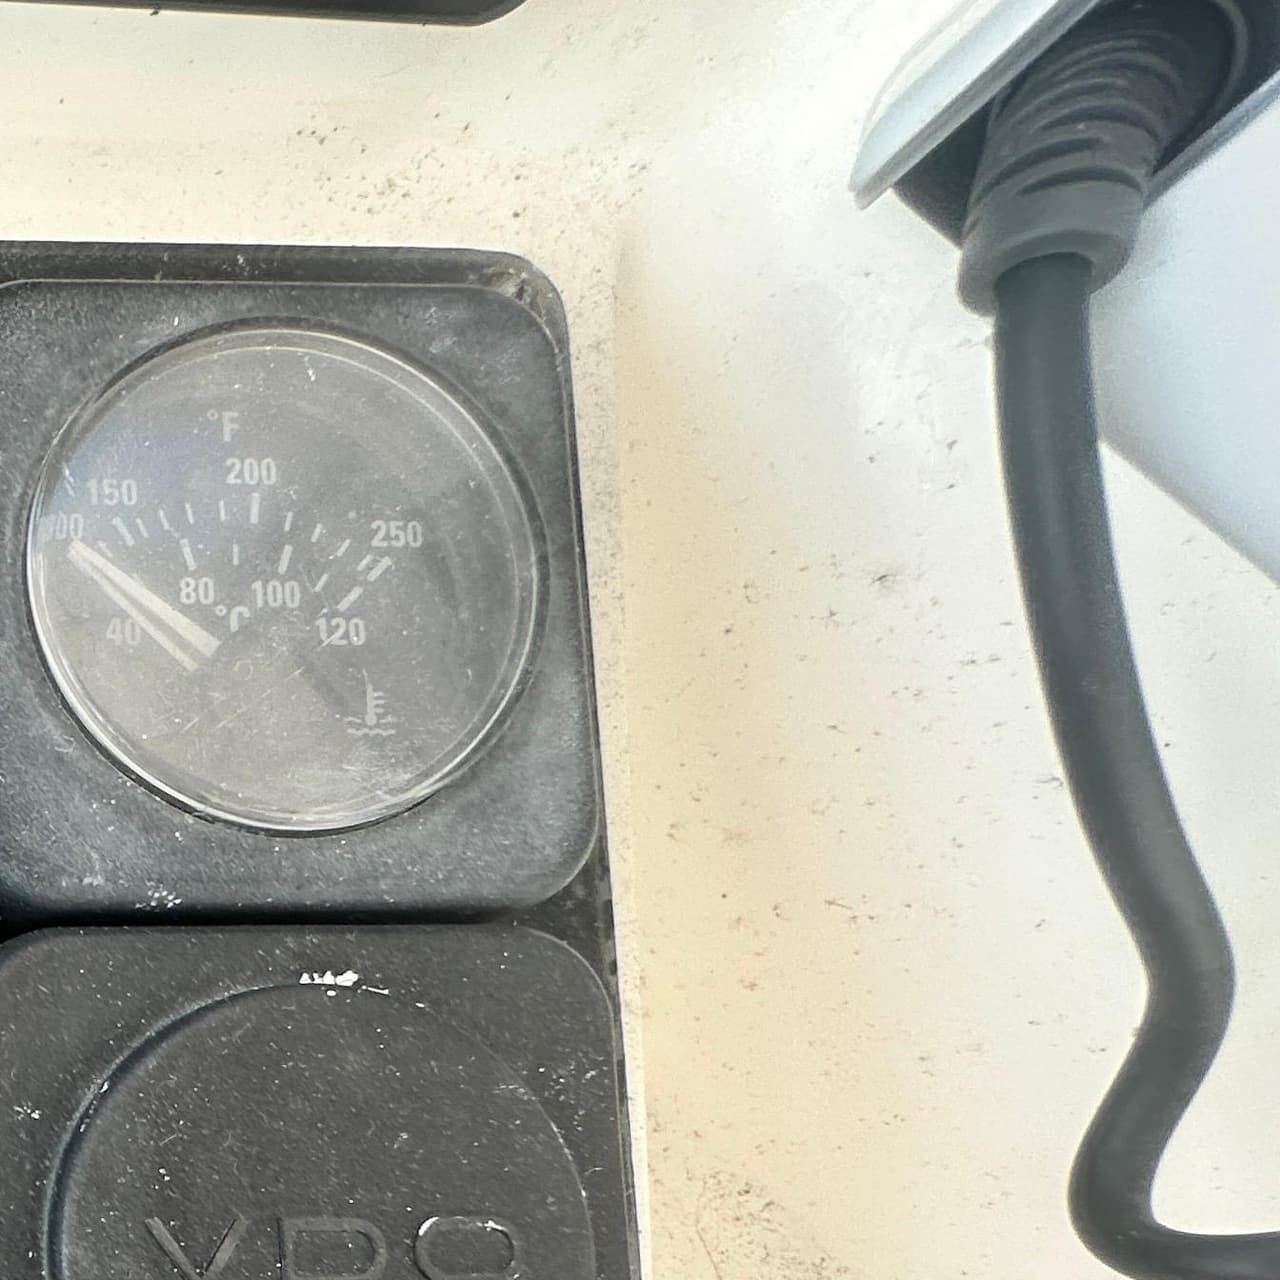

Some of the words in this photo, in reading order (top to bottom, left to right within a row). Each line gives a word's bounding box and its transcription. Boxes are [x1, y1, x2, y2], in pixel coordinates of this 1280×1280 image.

[225, 458, 277, 485] 200
[86, 479, 137, 506] 150
[371, 520, 423, 547] 250
[180, 577, 215, 605] 80
[251, 580, 301, 609] 100
[106, 617, 141, 647] 40
[315, 616, 366, 646] 120
